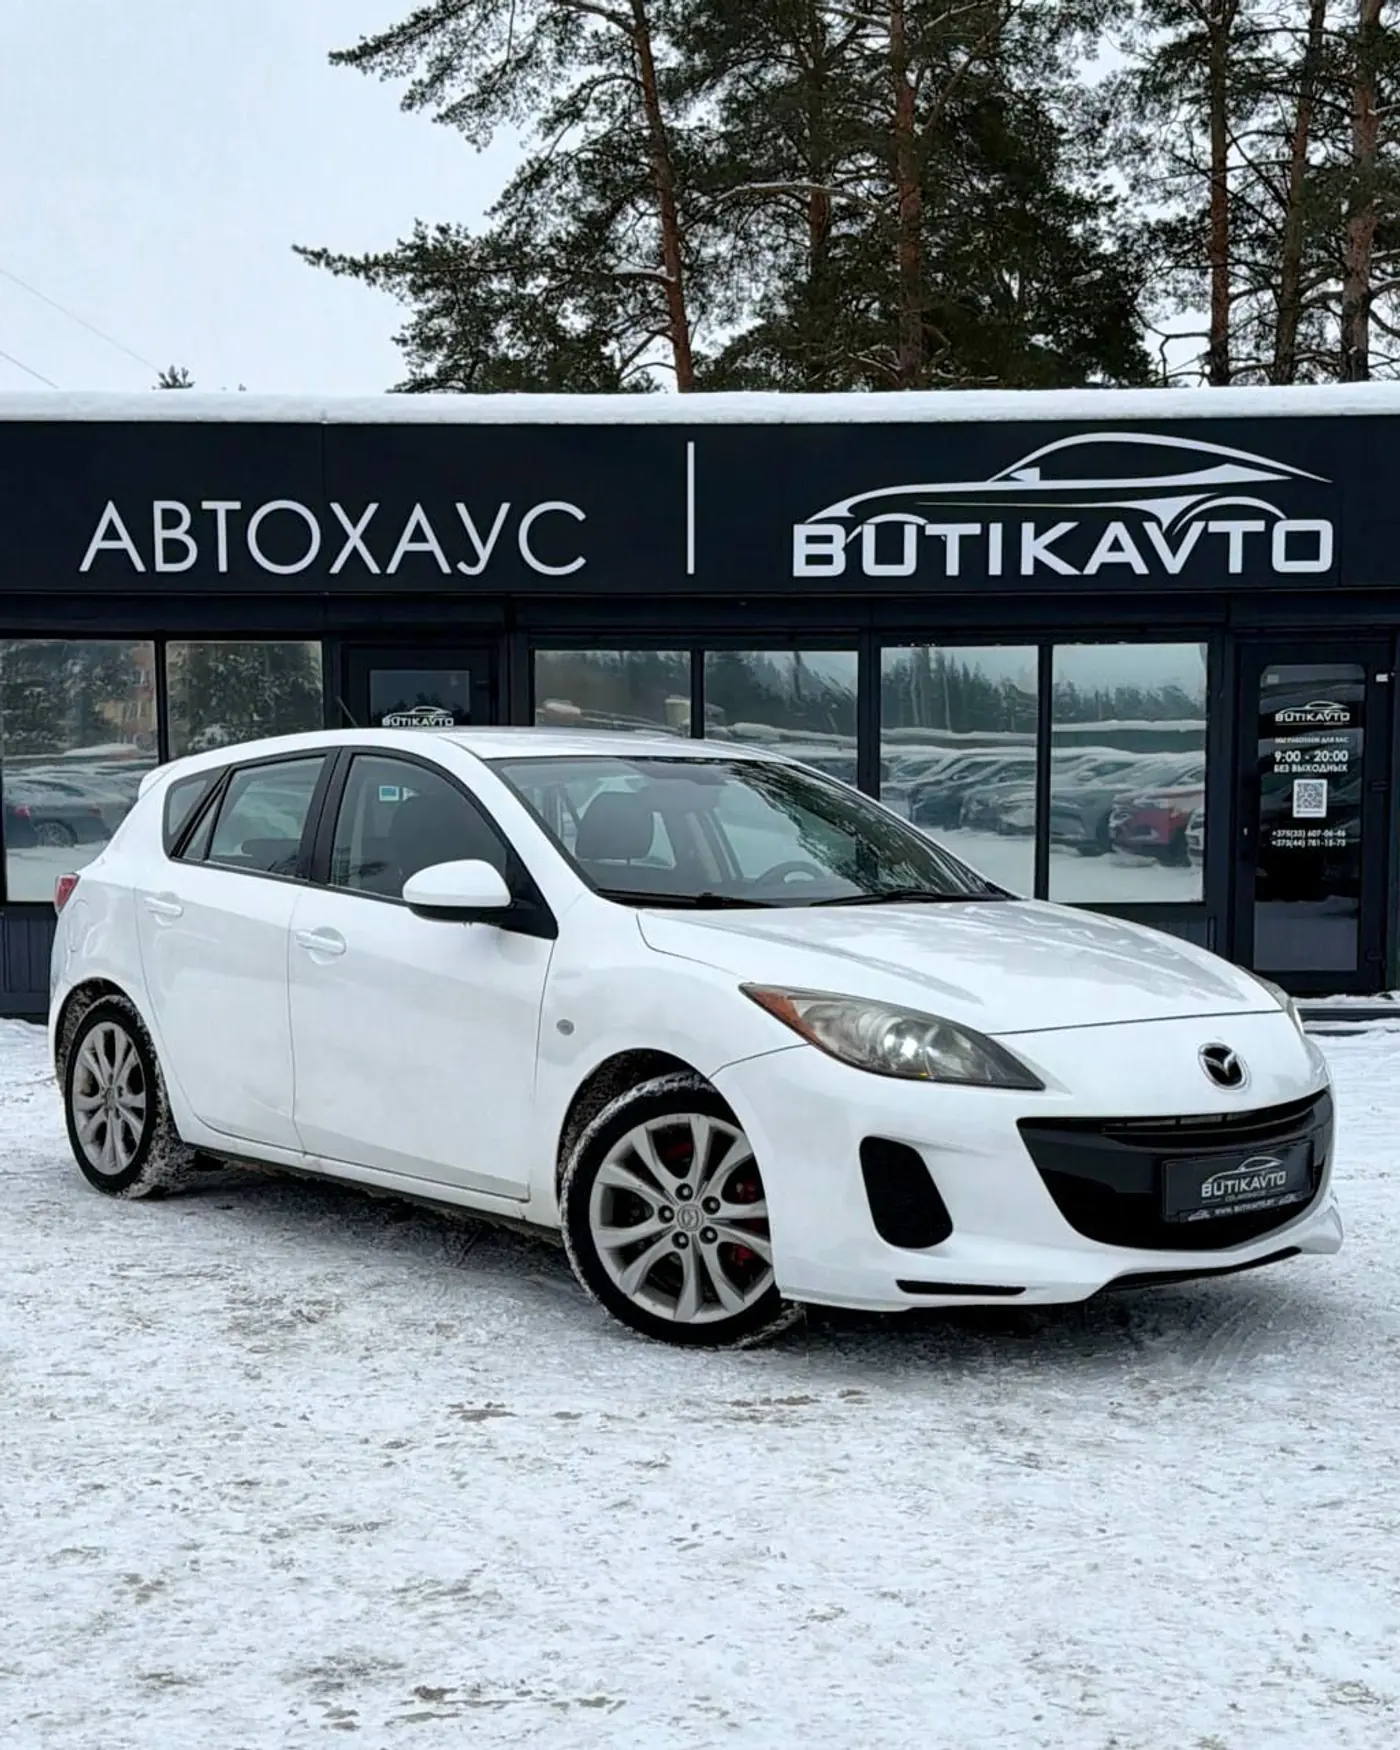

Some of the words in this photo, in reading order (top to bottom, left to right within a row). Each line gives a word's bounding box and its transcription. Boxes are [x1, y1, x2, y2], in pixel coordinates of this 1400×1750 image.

[79, 499, 586, 576] АВТОХАУС
[792, 518, 1334, 577] BUTIKAVTO
[382, 717, 454, 727] BUTIKAVTO
[1275, 712, 1350, 722] BUTIKAVTO
[1274, 750, 1301, 762] 9:00
[1314, 750, 1349, 762] 20:00
[1274, 764, 1290, 773] БЕЗ
[1291, 764, 1348, 774] ВЫХОДНЫХ
[1201, 1171, 1287, 1198] BUTIKAVTO
